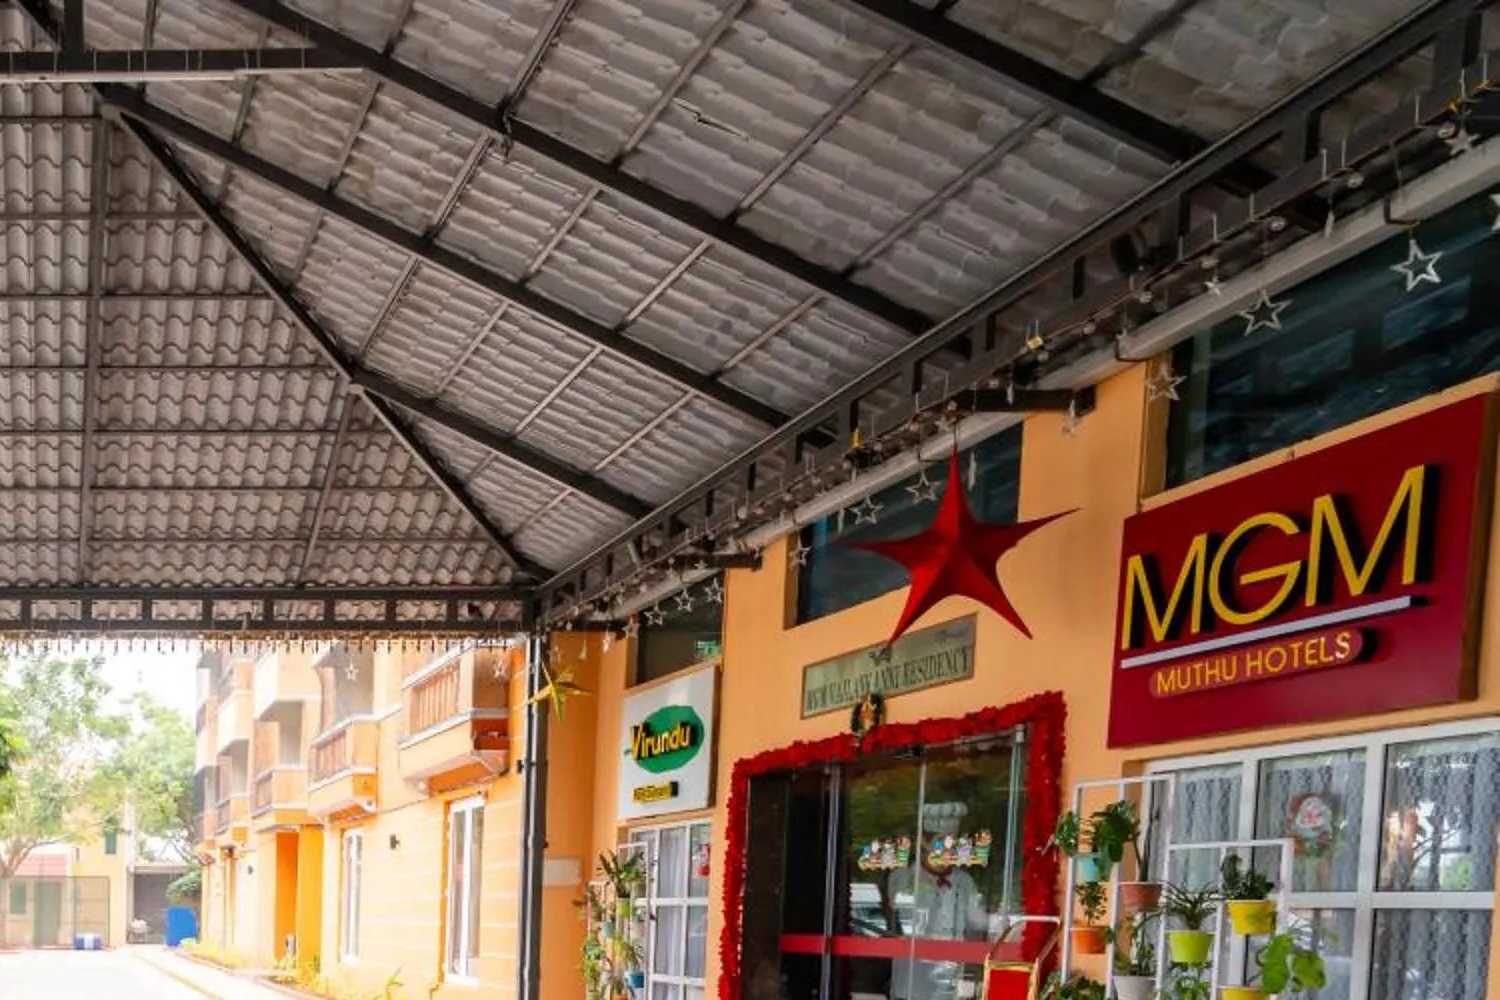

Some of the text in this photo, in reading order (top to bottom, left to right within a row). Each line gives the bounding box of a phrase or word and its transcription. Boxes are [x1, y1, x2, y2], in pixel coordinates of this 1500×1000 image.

[1121, 464, 1425, 651] MGM
[903, 647, 969, 686] RESIDENCY
[1155, 631, 1352, 696] MUTHU HOTELS
[630, 721, 691, 760] Virundu
